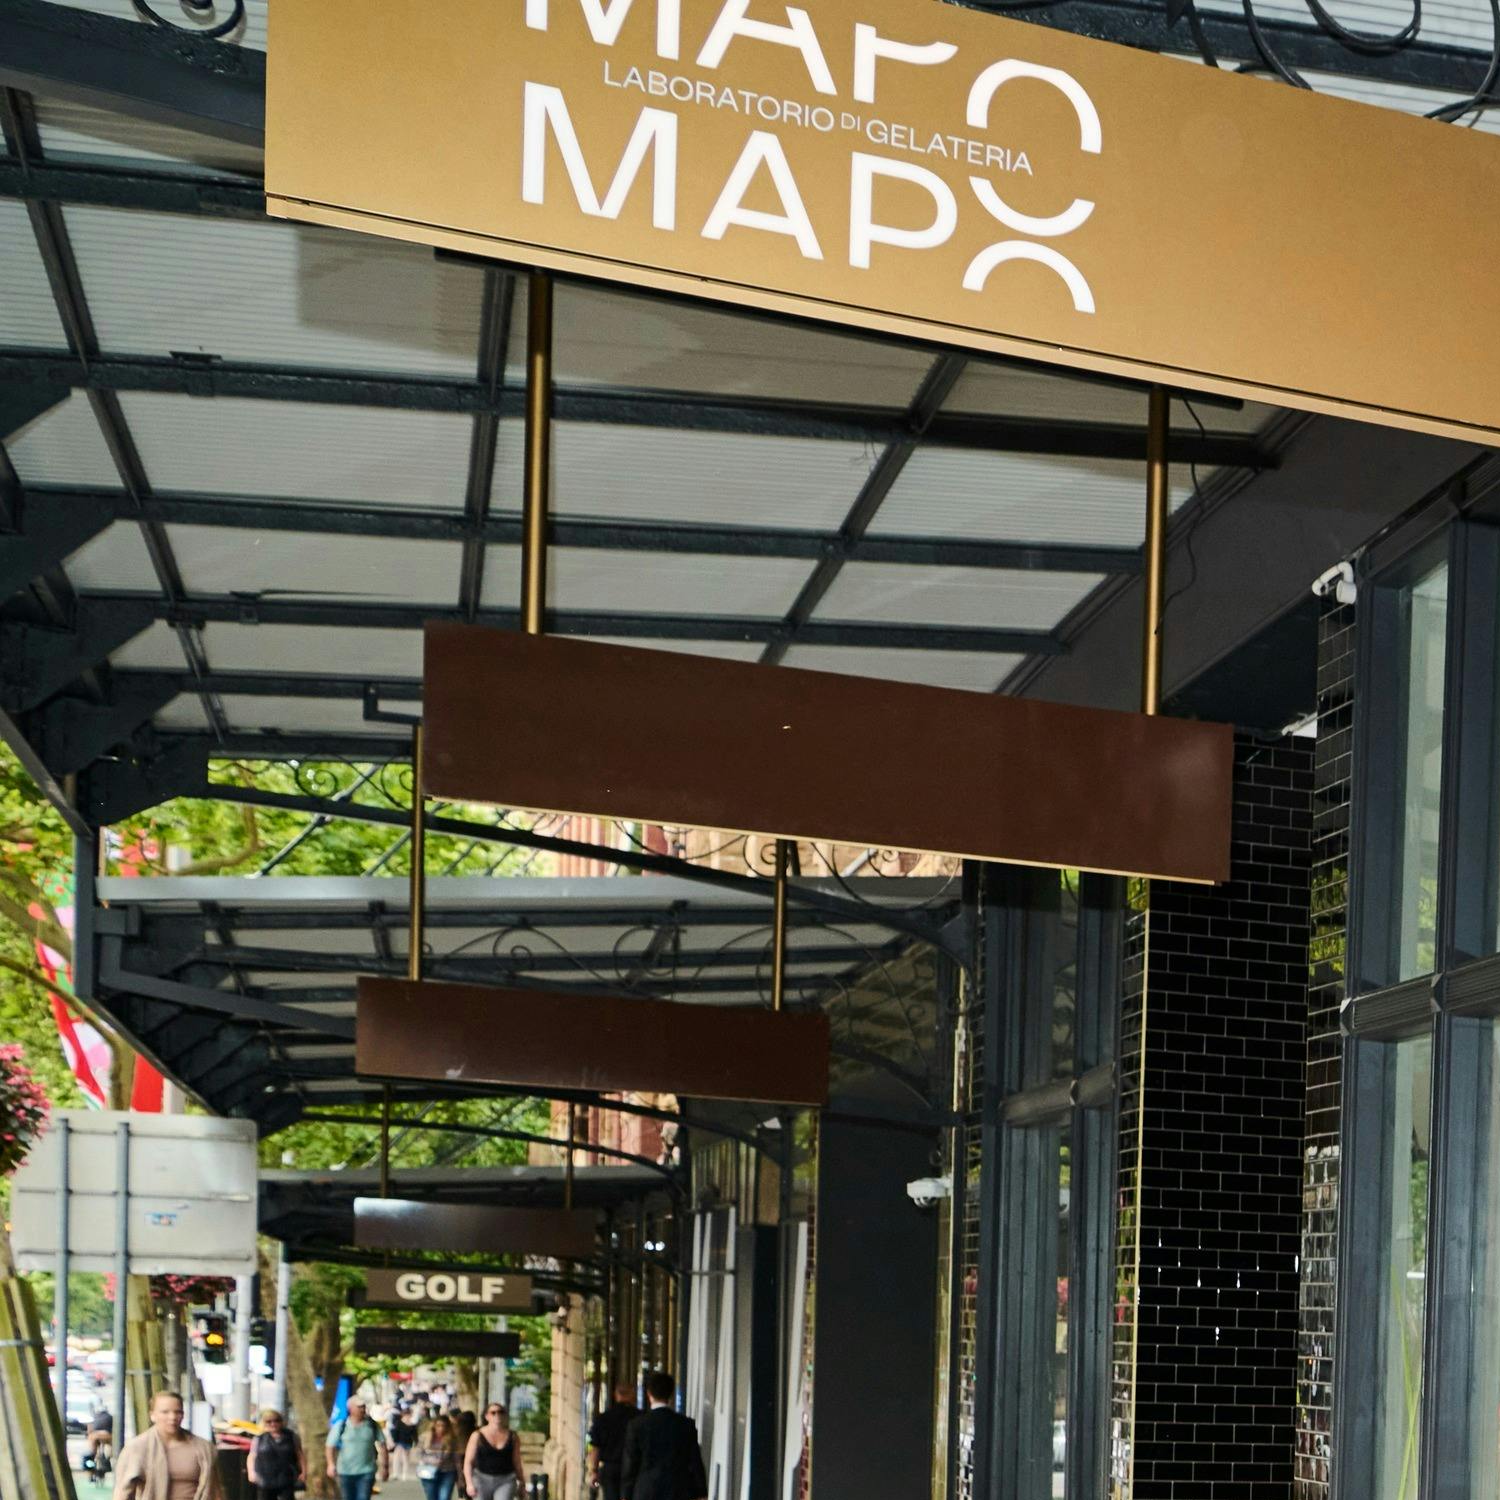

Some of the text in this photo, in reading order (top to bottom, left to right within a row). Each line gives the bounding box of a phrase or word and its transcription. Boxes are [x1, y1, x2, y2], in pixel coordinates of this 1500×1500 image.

[603, 60, 1033, 176] LABORATORIO DI GELATERIA
[395, 1273, 505, 1303] GOLF
